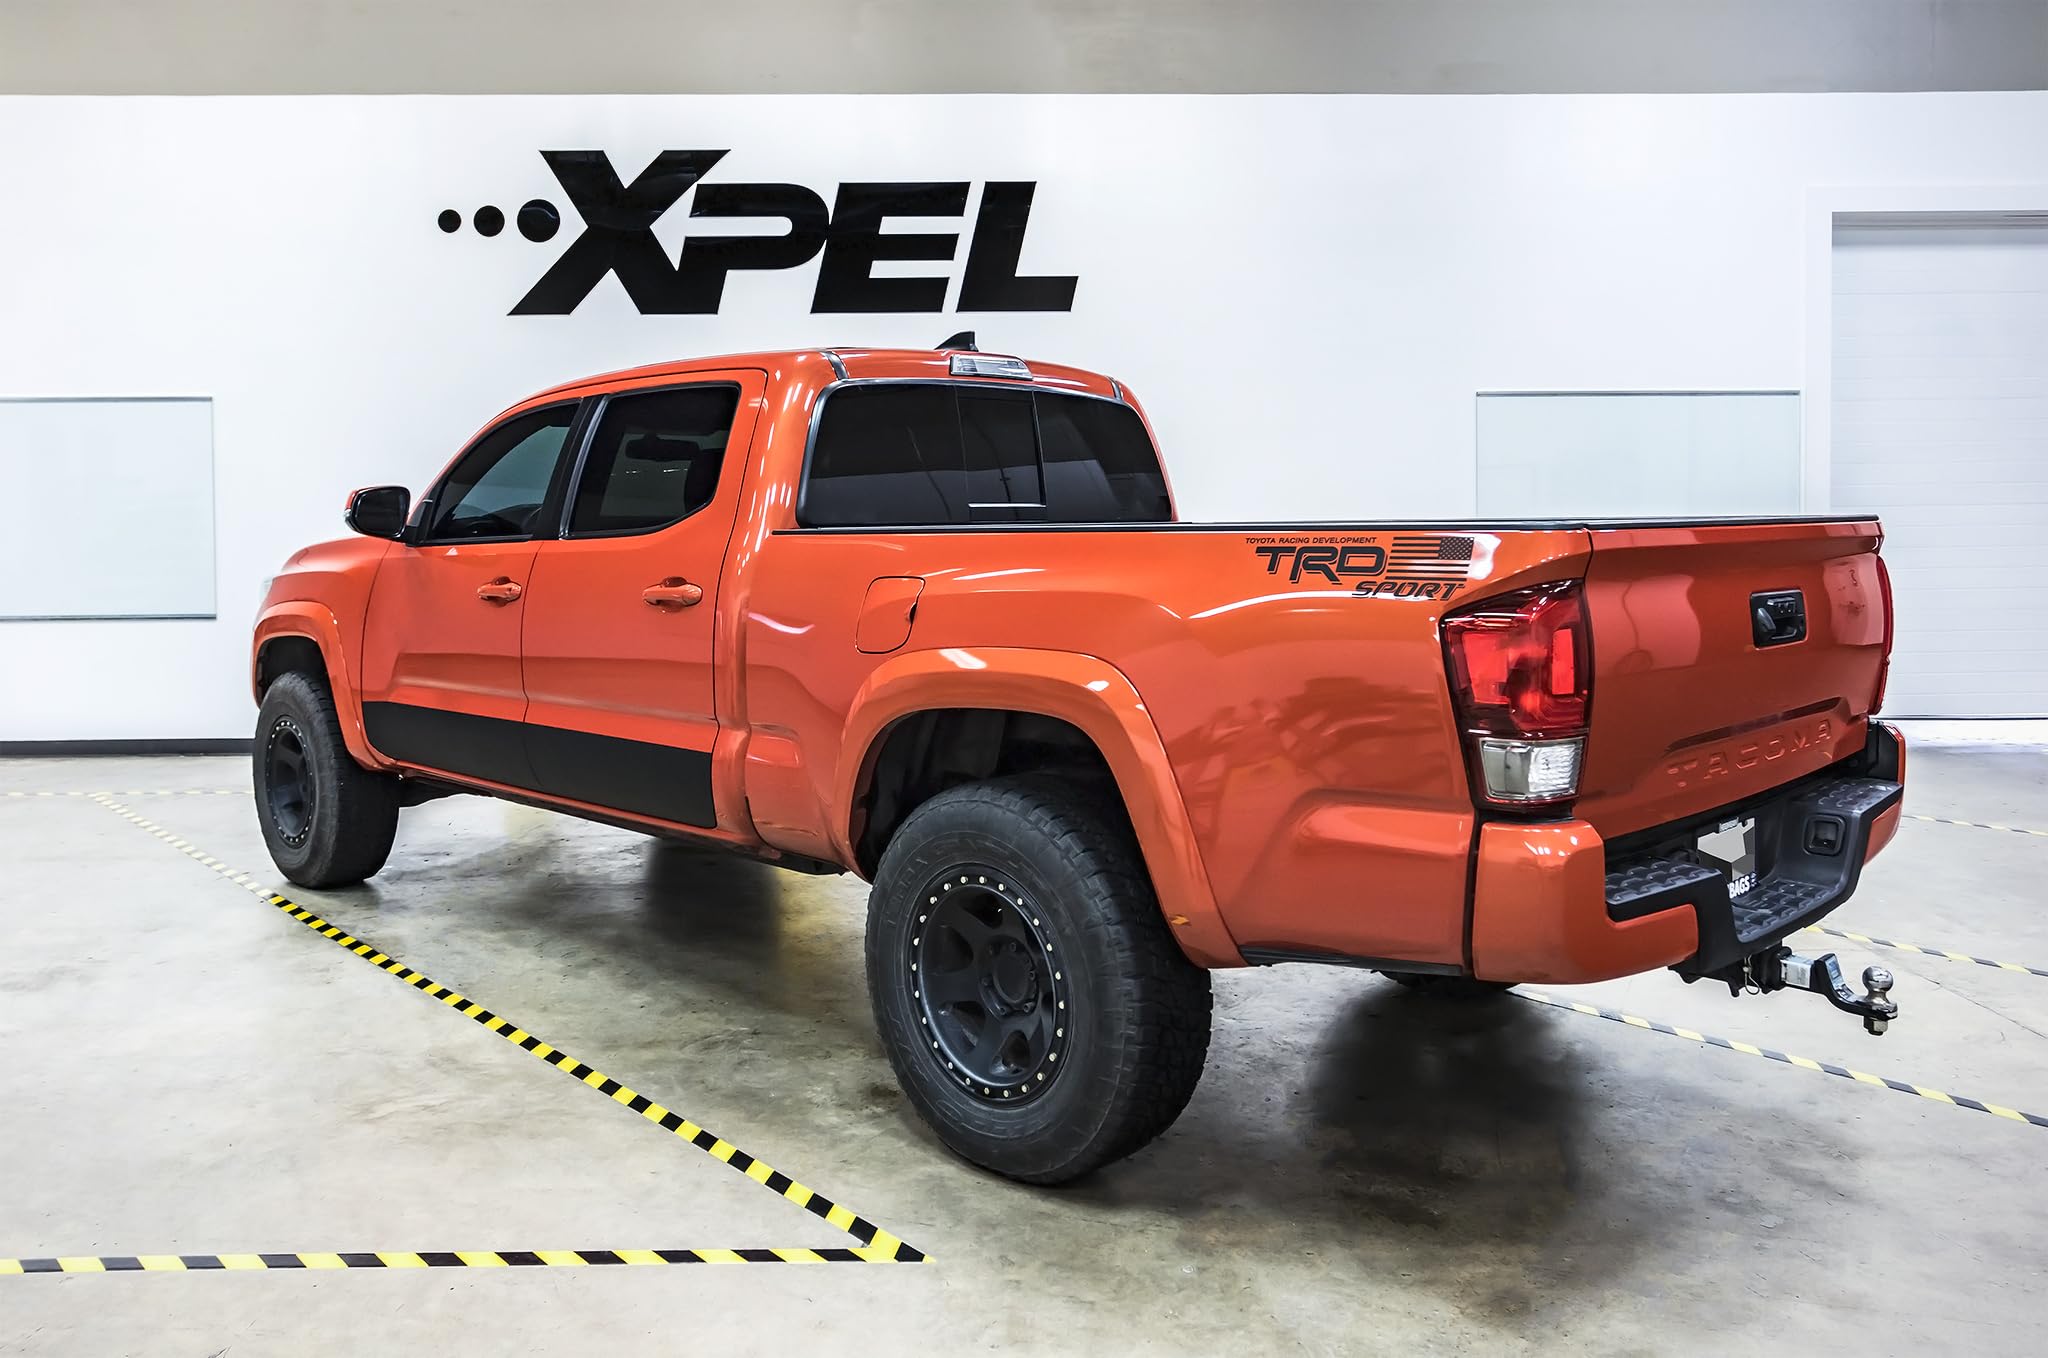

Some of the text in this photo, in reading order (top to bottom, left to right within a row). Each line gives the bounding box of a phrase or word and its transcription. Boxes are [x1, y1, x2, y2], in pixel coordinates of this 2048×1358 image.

[507, 149, 1079, 315] XPEL
[1245, 535, 1377, 545] TOYOTA RACING DEVELOPMENT
[1255, 546, 1388, 585] TRD
[1352, 580, 1465, 601] SPORT
[1666, 718, 1832, 788] TACOMA
[1727, 875, 1751, 899] BAGS
